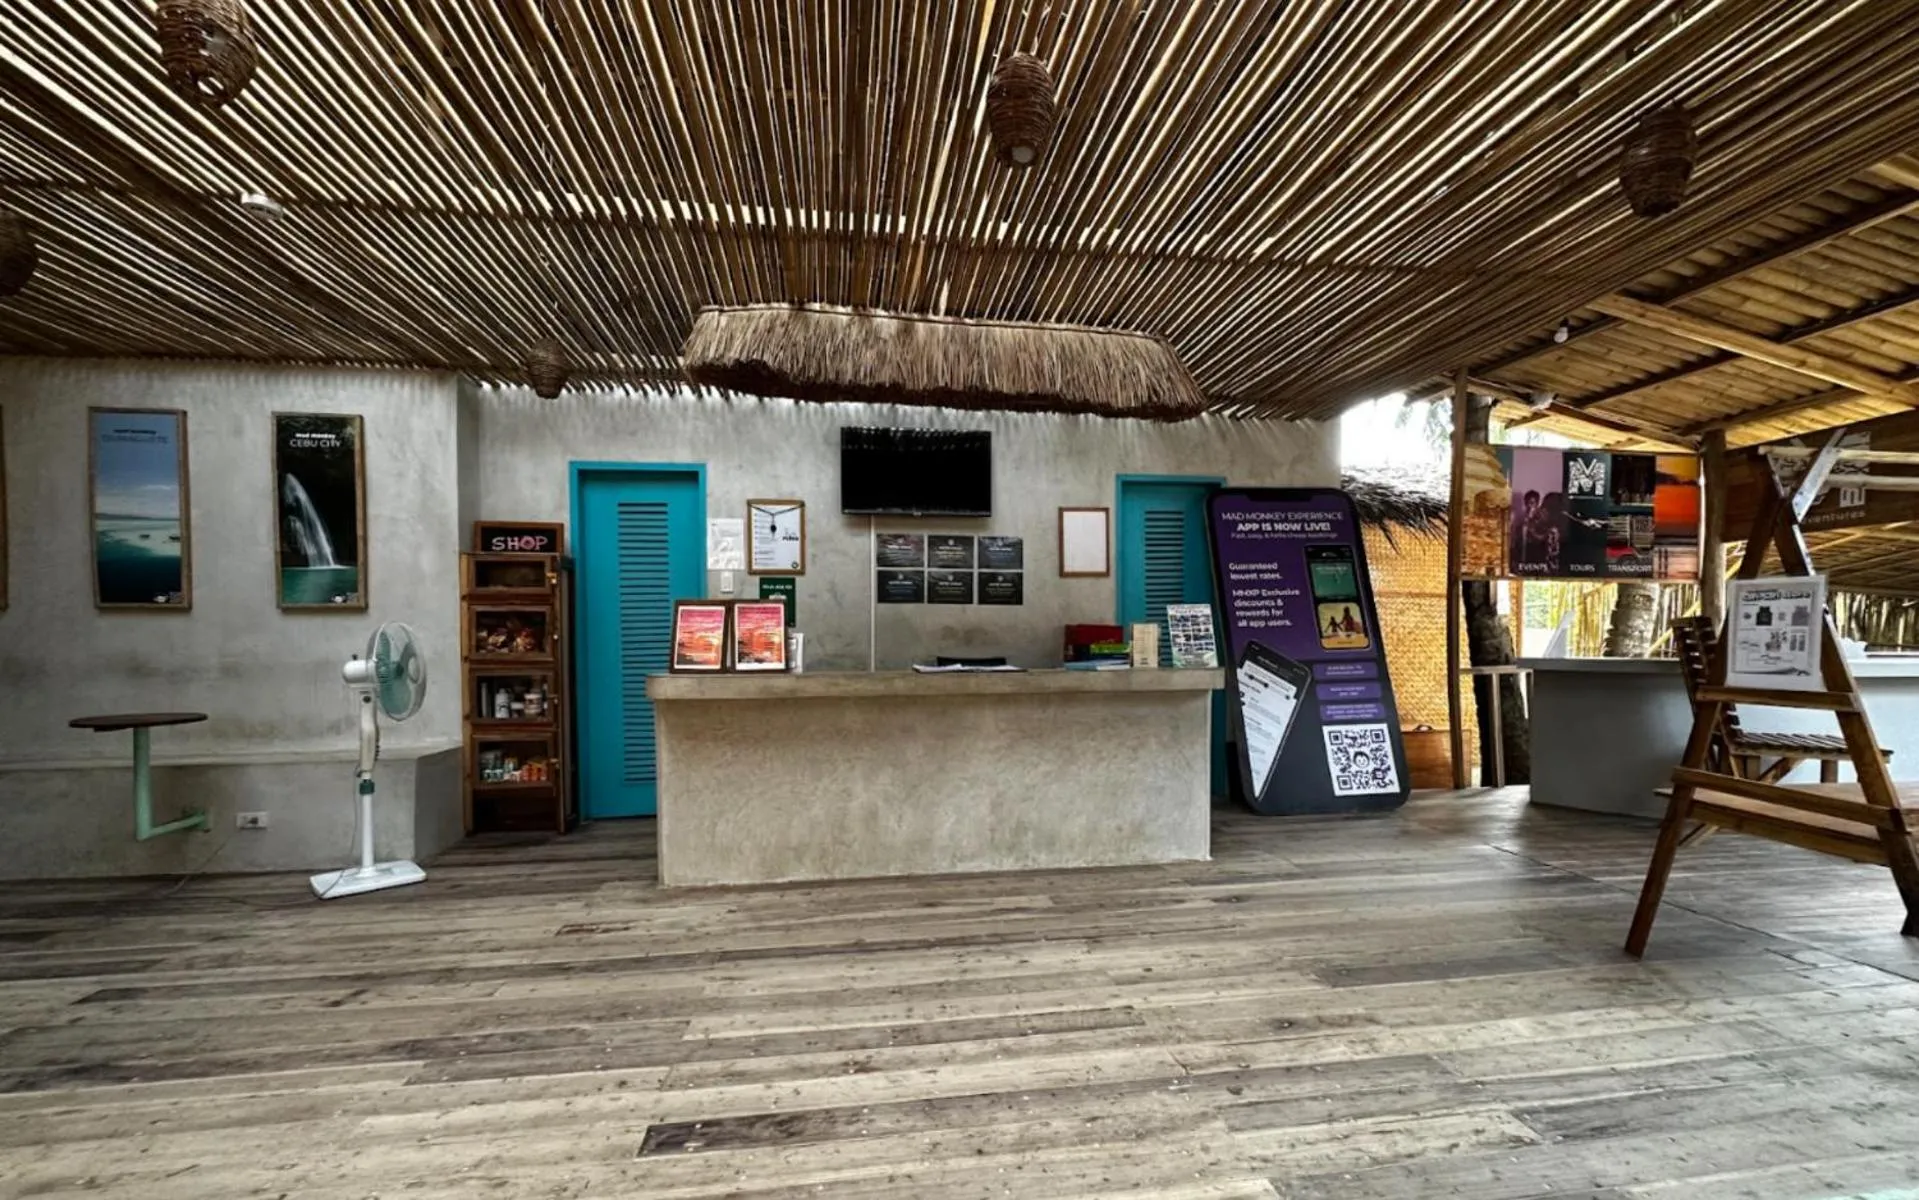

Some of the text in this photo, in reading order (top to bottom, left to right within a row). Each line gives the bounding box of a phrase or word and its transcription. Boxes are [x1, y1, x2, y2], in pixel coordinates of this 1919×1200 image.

[289, 439, 342, 448] CEBU CITY
[1221, 511, 1343, 521] MAD MONKEY EXPERIENCE
[1236, 521, 1331, 531] APP IS NOW LIVE!
[491, 535, 549, 551] SHOP
[1228, 562, 1278, 570] Guaranteed
[1518, 563, 1548, 572] EVENTS
[1570, 563, 1595, 572] TOURS
[1607, 563, 1653, 573] TRANSPORT
[1230, 572, 1283, 580] lowest rates.
[1261, 588, 1301, 596] Exclusive
[1234, 598, 1284, 607] discounts &
[1235, 608, 1284, 617] rewards for
[1237, 619, 1248, 627] all
[1249, 620, 1266, 628] app
